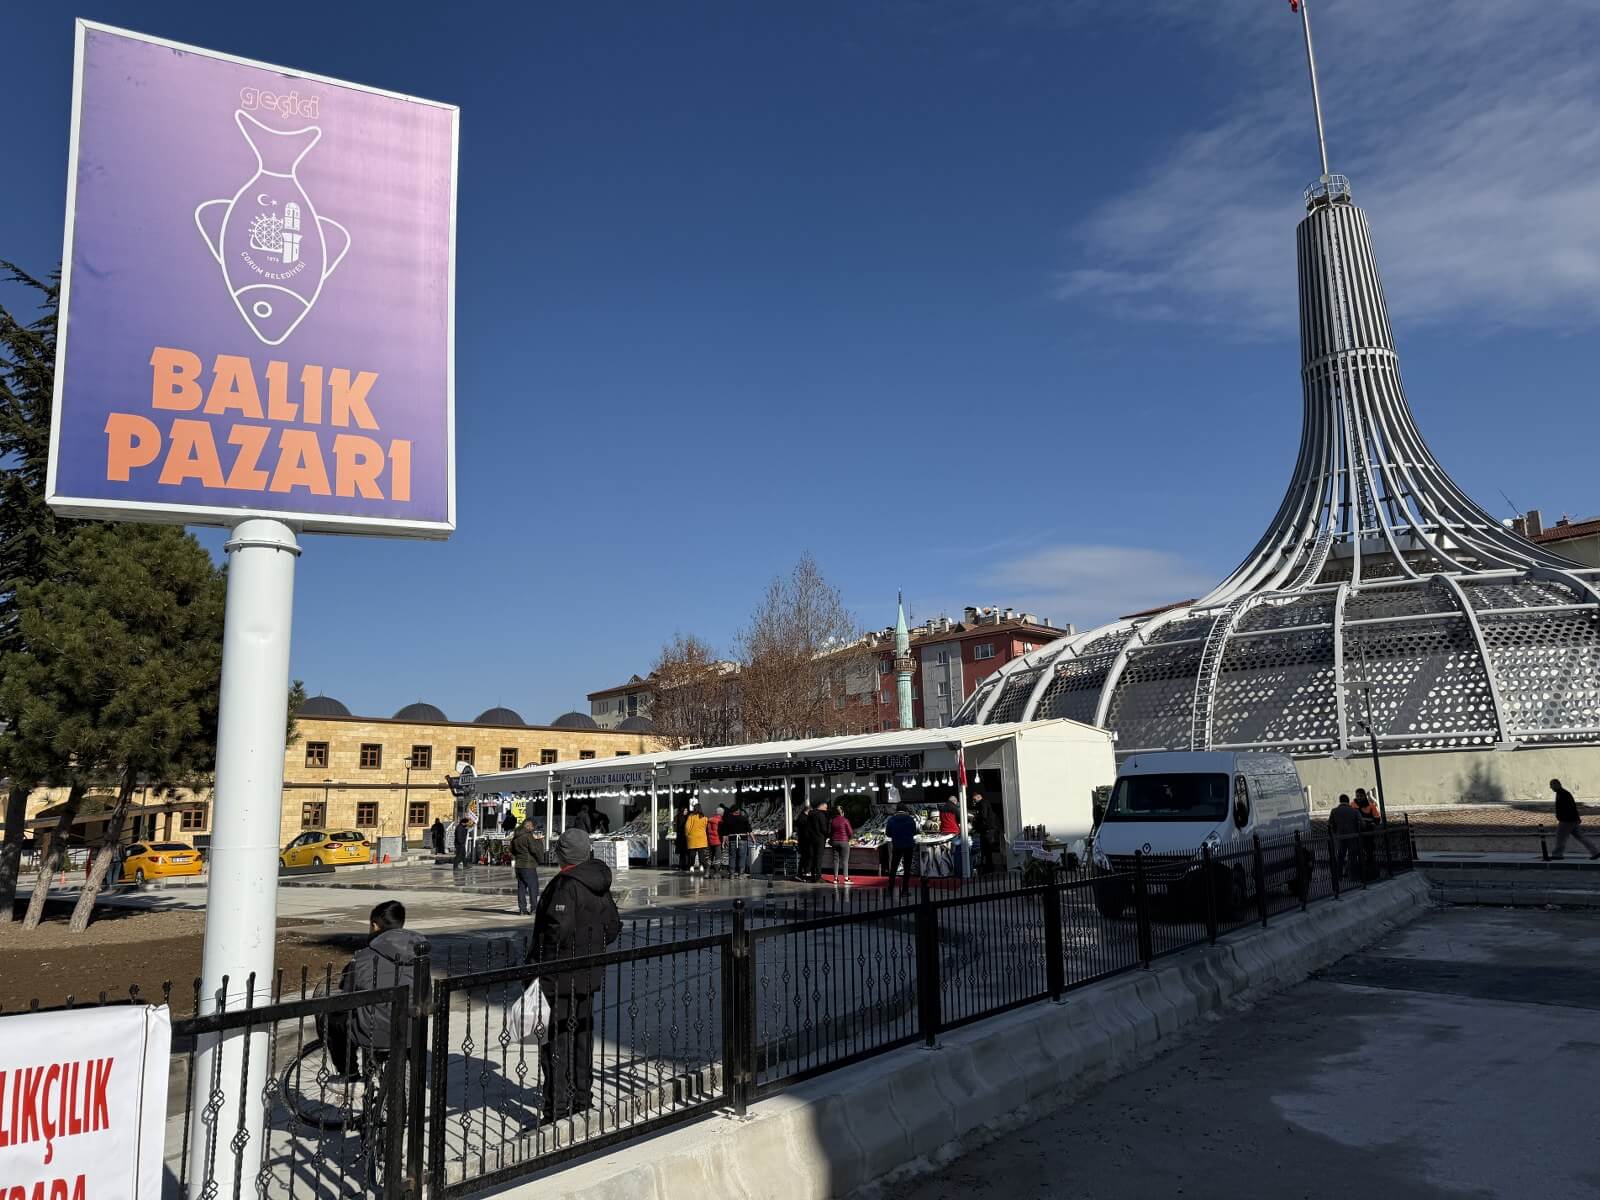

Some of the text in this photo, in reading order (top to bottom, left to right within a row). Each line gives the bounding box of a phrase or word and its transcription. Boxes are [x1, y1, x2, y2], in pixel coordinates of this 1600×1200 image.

[240, 86, 319, 120] geçici
[150, 346, 380, 431] BALIK
[104, 412, 412, 502] PAZARI
